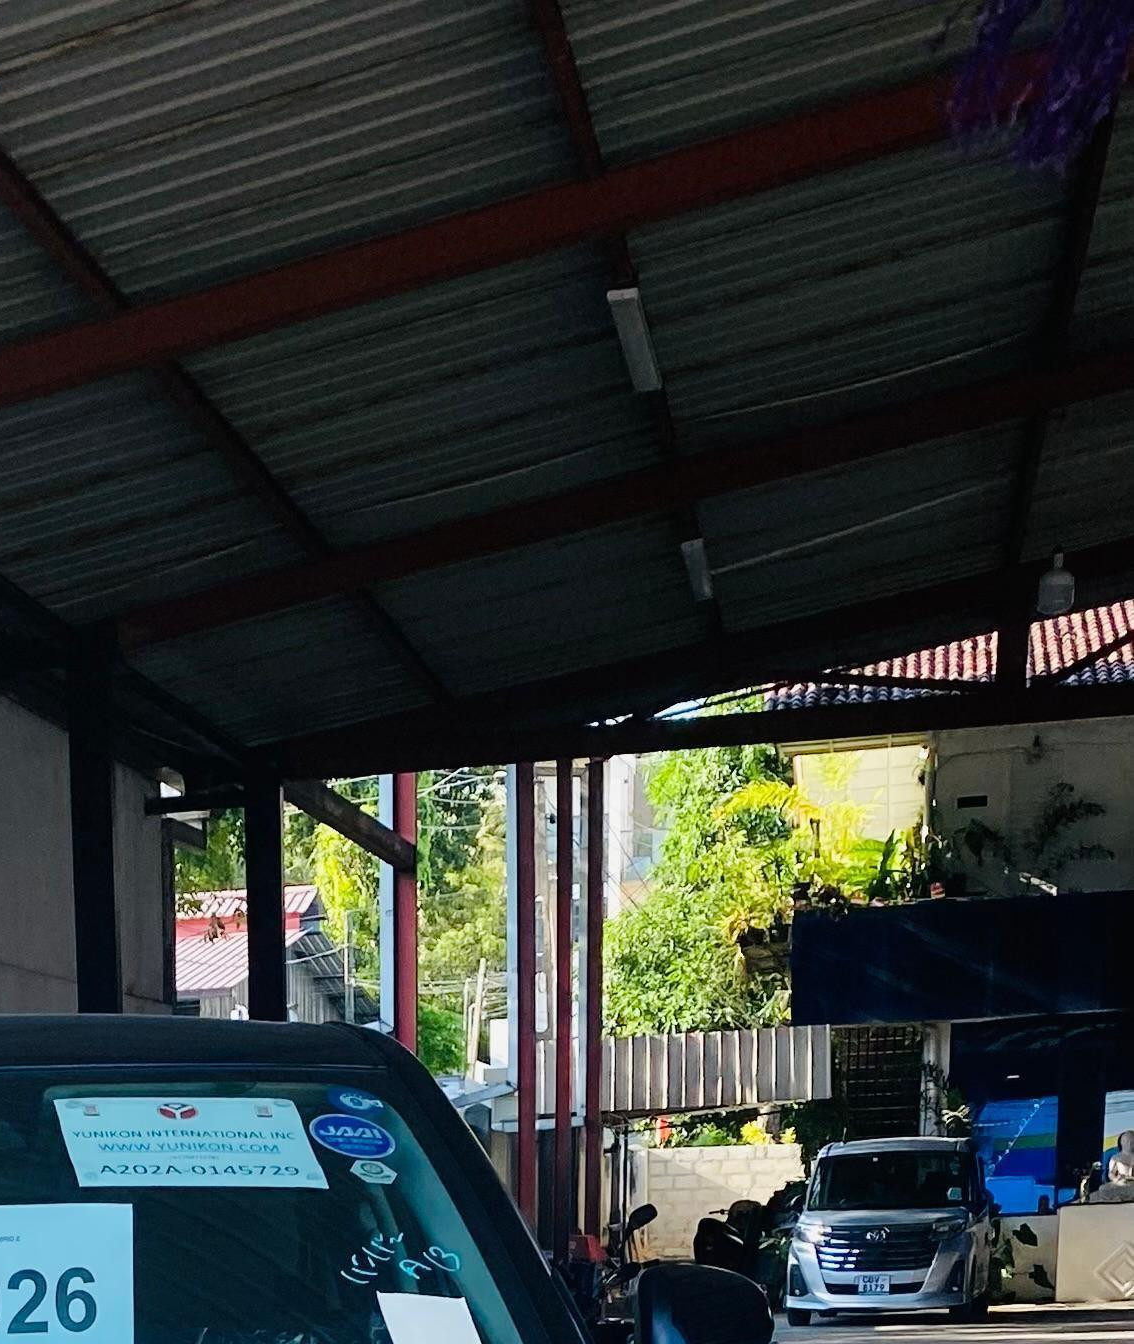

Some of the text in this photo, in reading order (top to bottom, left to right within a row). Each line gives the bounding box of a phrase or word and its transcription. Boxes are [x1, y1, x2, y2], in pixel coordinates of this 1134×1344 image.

[72, 1129, 295, 1140] YUNIKON INTERNATIONAL INC
[100, 1164, 300, 1176] A202A-0145729
